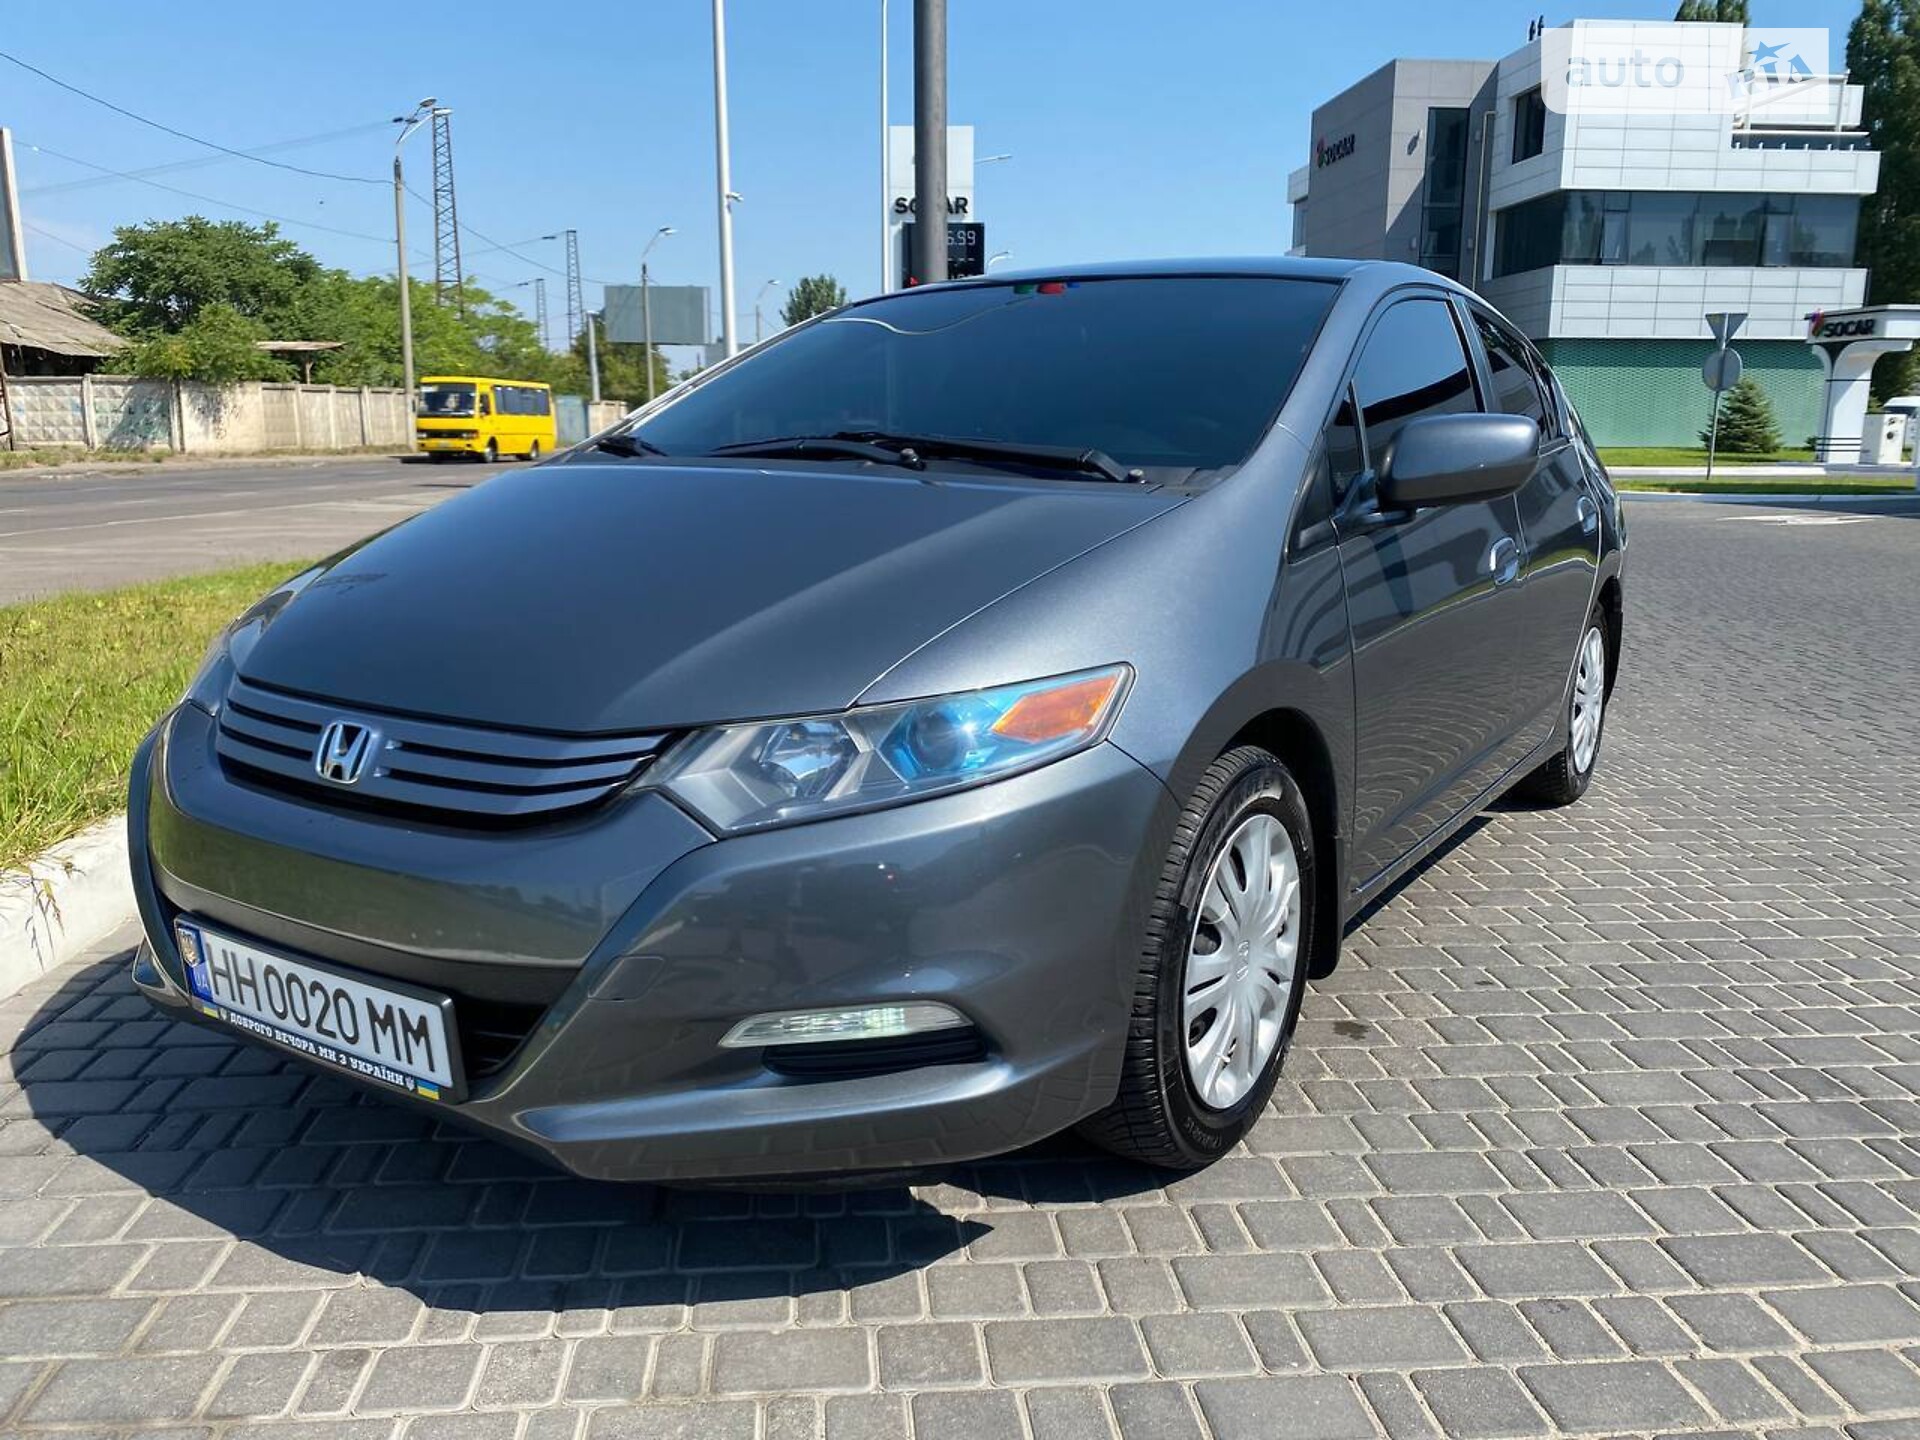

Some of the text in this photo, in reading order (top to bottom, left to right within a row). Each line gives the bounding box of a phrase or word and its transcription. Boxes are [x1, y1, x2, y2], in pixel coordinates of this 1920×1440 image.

[894, 197, 969, 214] SAR
[1823, 318, 1875, 338] SOCAR
[230, 1012, 273, 1038] ДОБРОГО
[275, 1029, 316, 1055] ВЕЧОРА
